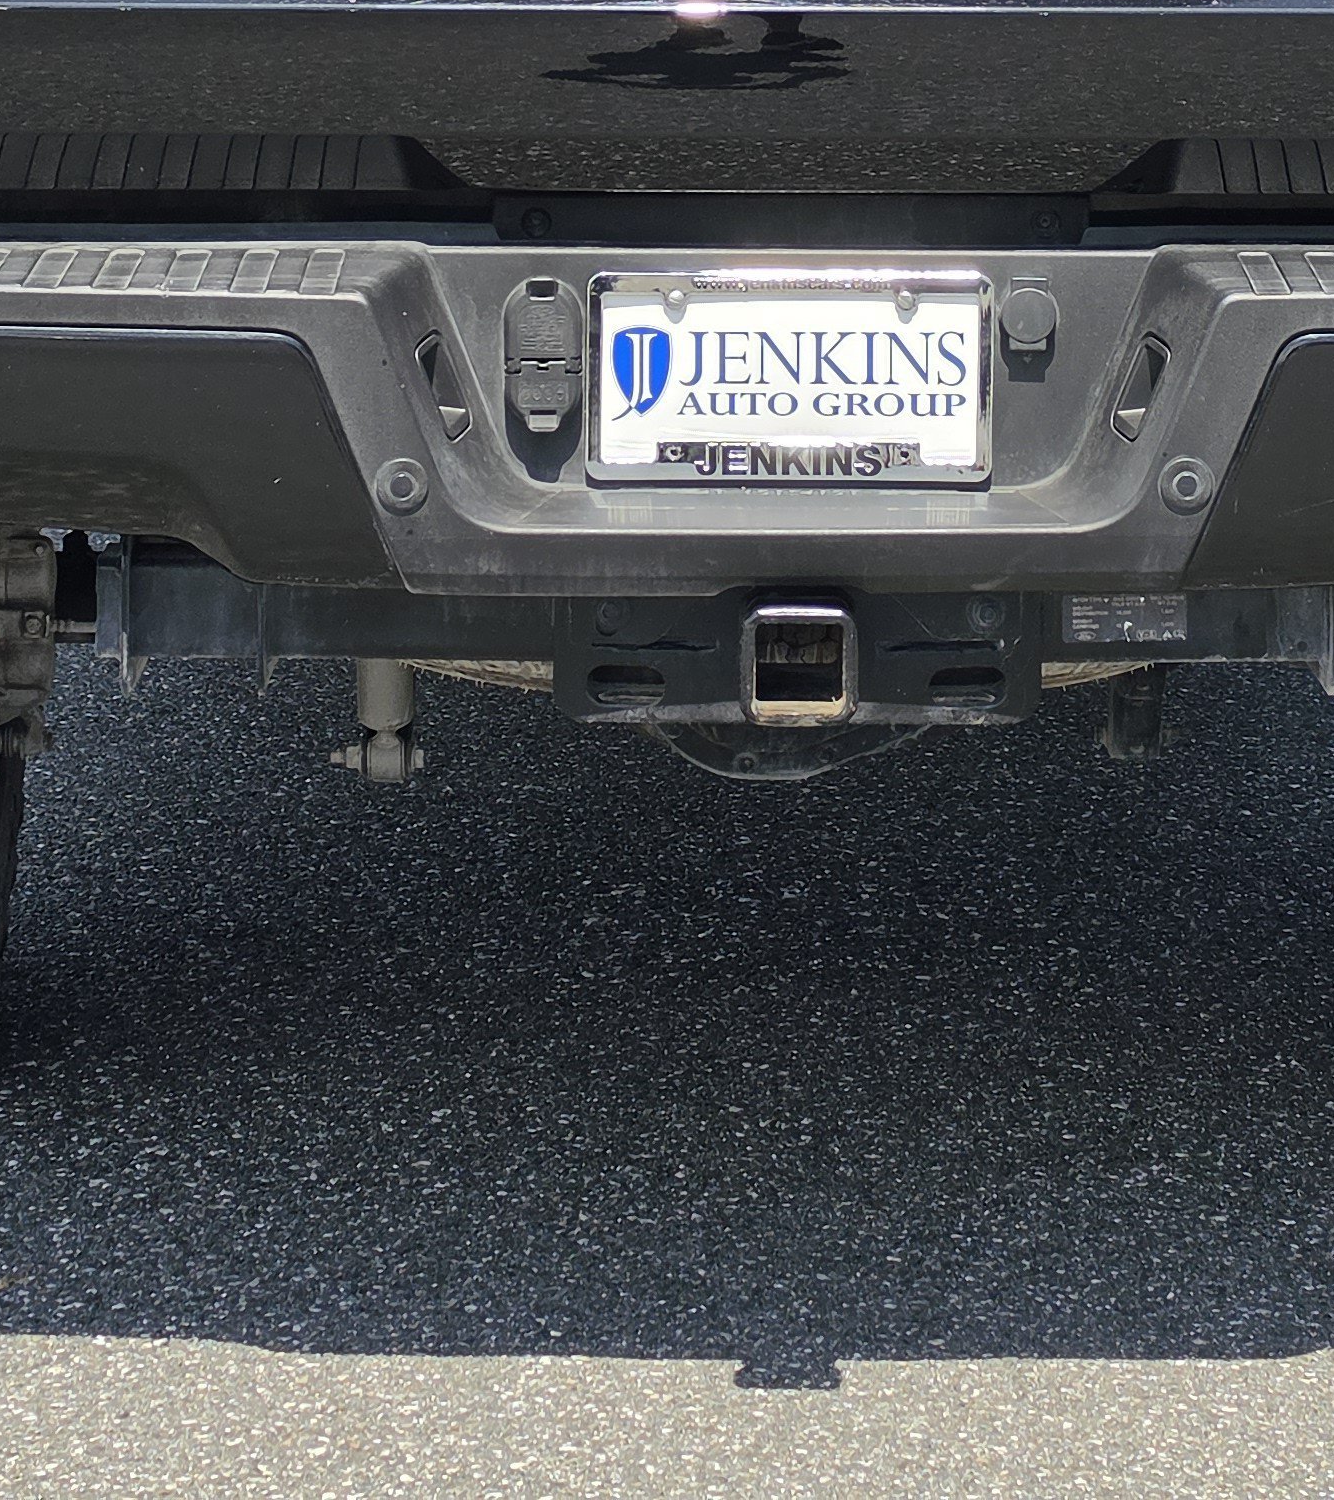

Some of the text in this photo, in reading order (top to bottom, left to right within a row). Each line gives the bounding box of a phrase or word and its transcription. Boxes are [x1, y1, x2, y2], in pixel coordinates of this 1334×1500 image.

[680, 330, 966, 387] JENKINS
[677, 392, 966, 417] AUTO GROUP
[694, 442, 883, 477] JENKINS
